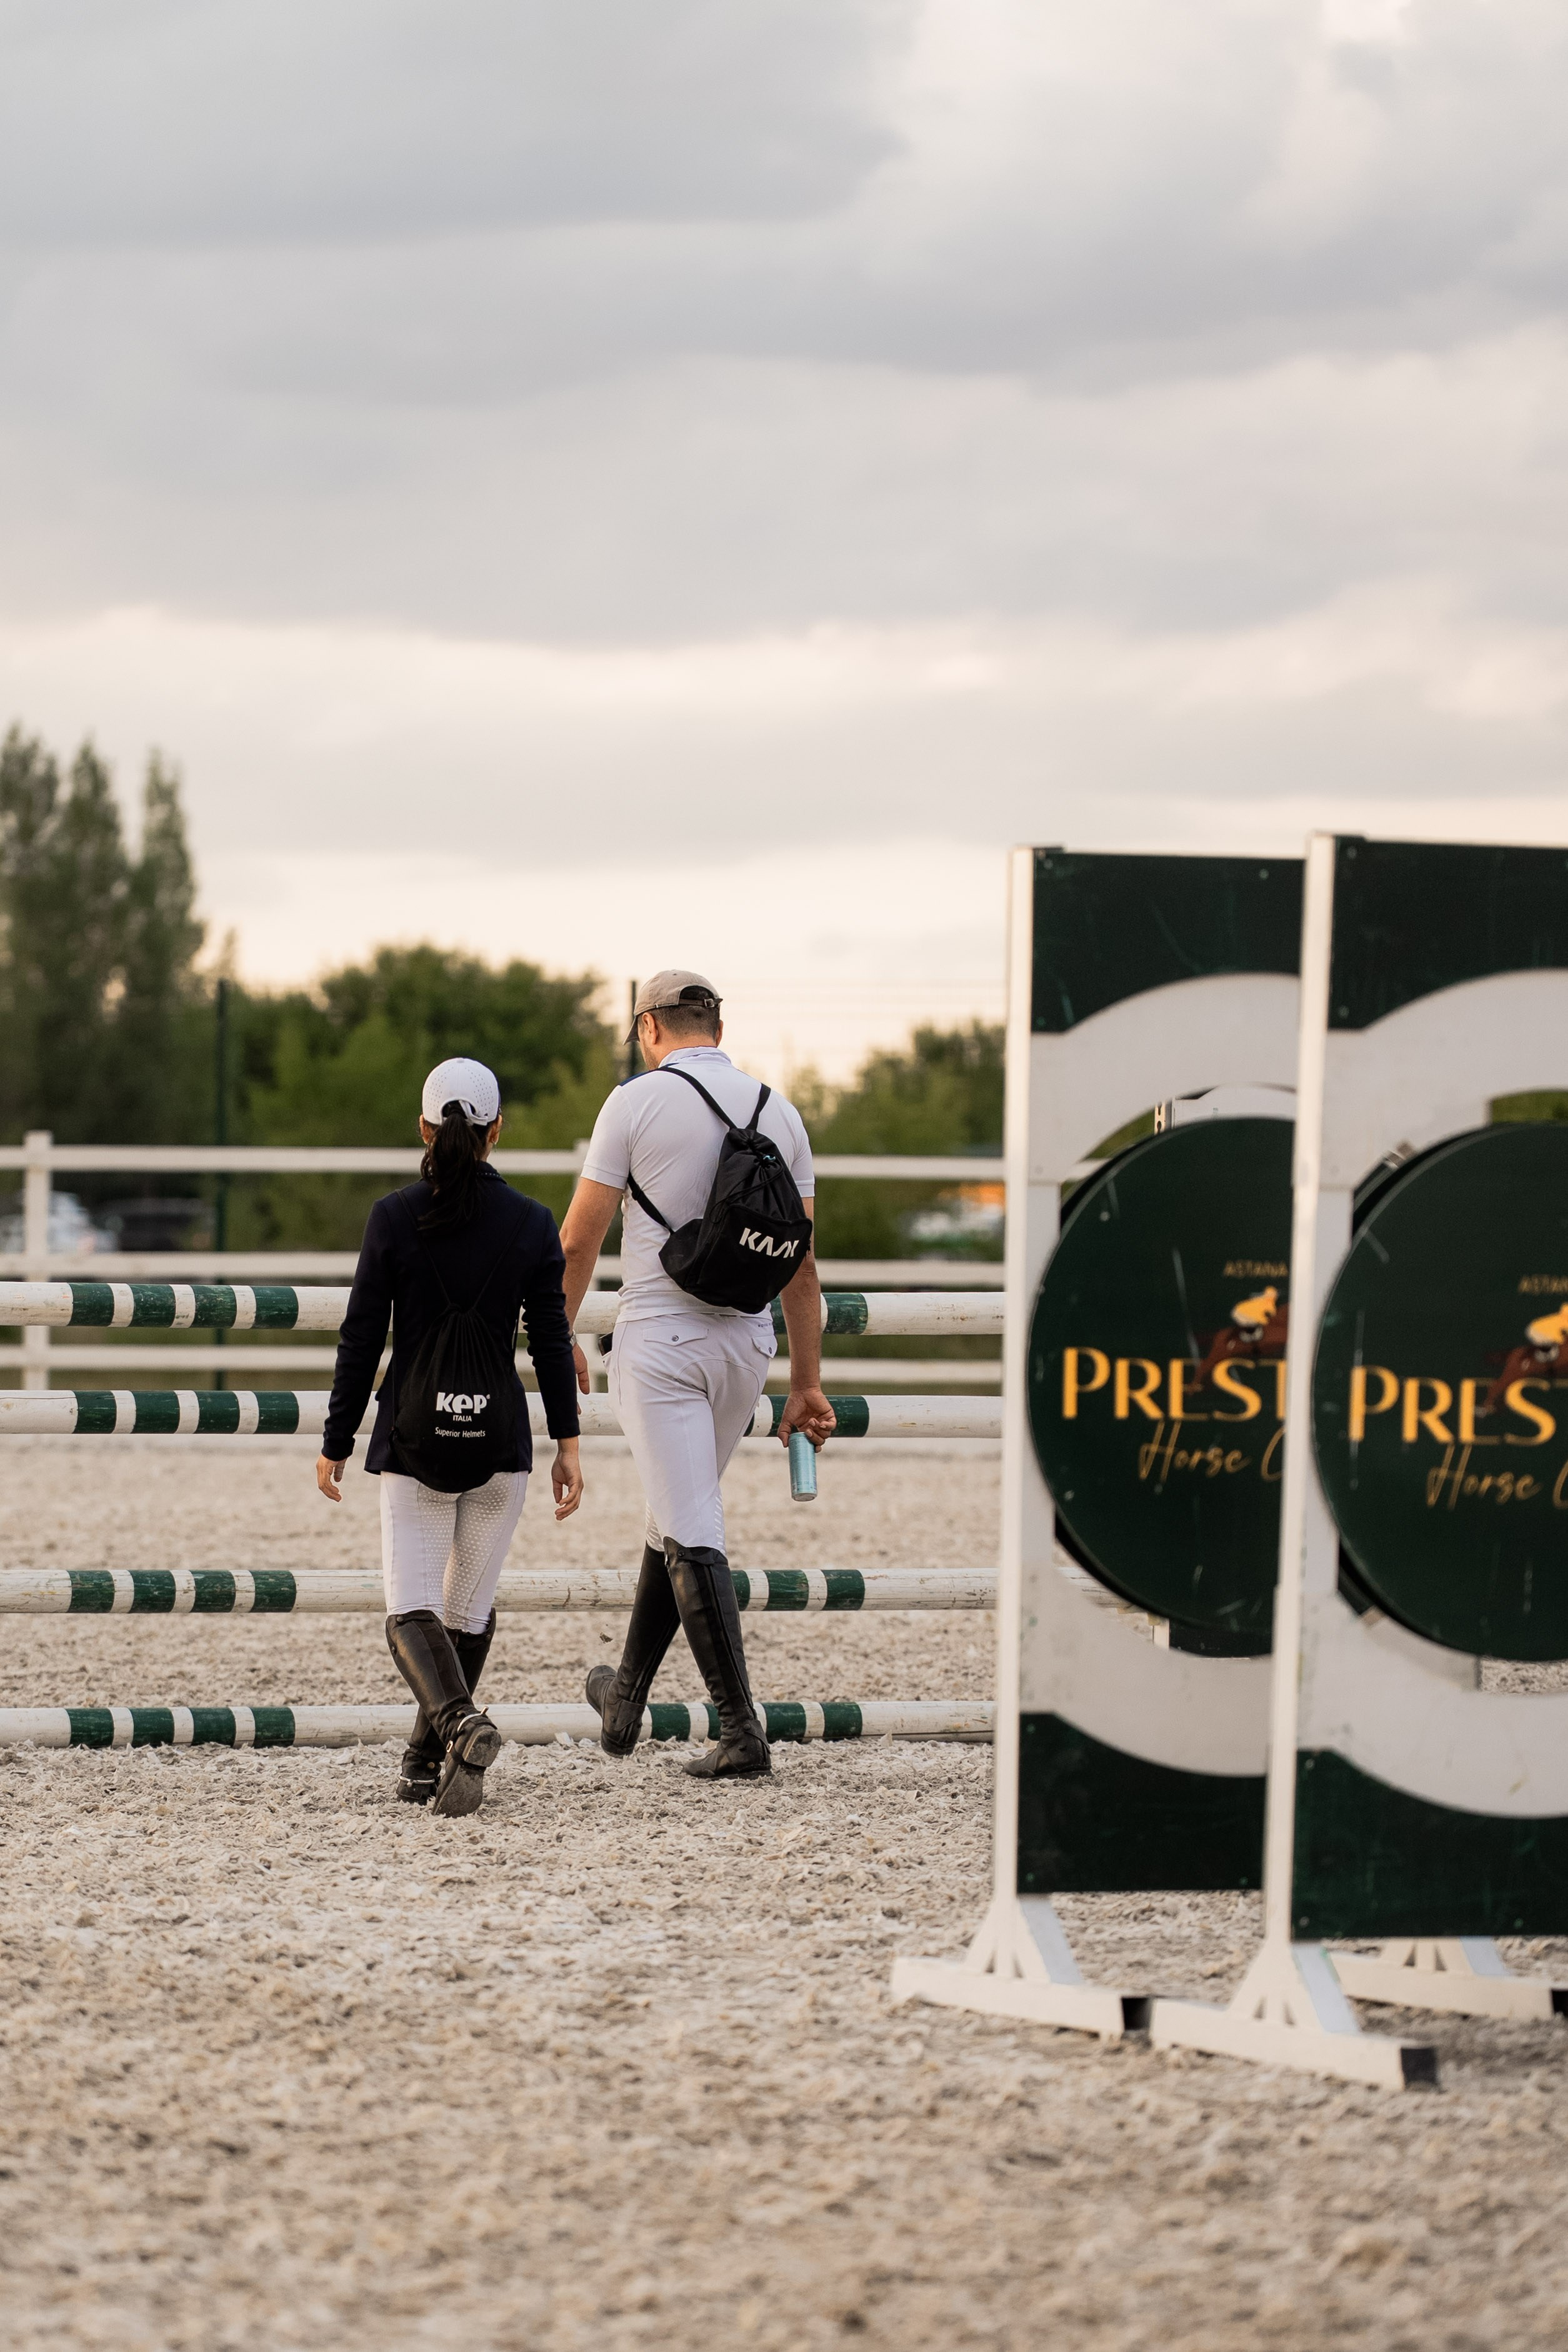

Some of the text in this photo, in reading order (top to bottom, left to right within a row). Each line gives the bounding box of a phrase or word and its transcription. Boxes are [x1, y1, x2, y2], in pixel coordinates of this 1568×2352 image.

[435, 1427, 486, 1438] Superior Helmets
[1348, 1364, 1568, 1446] PRES
[1139, 1420, 1252, 1483] Horse
[1426, 1443, 1542, 1511] Horse
